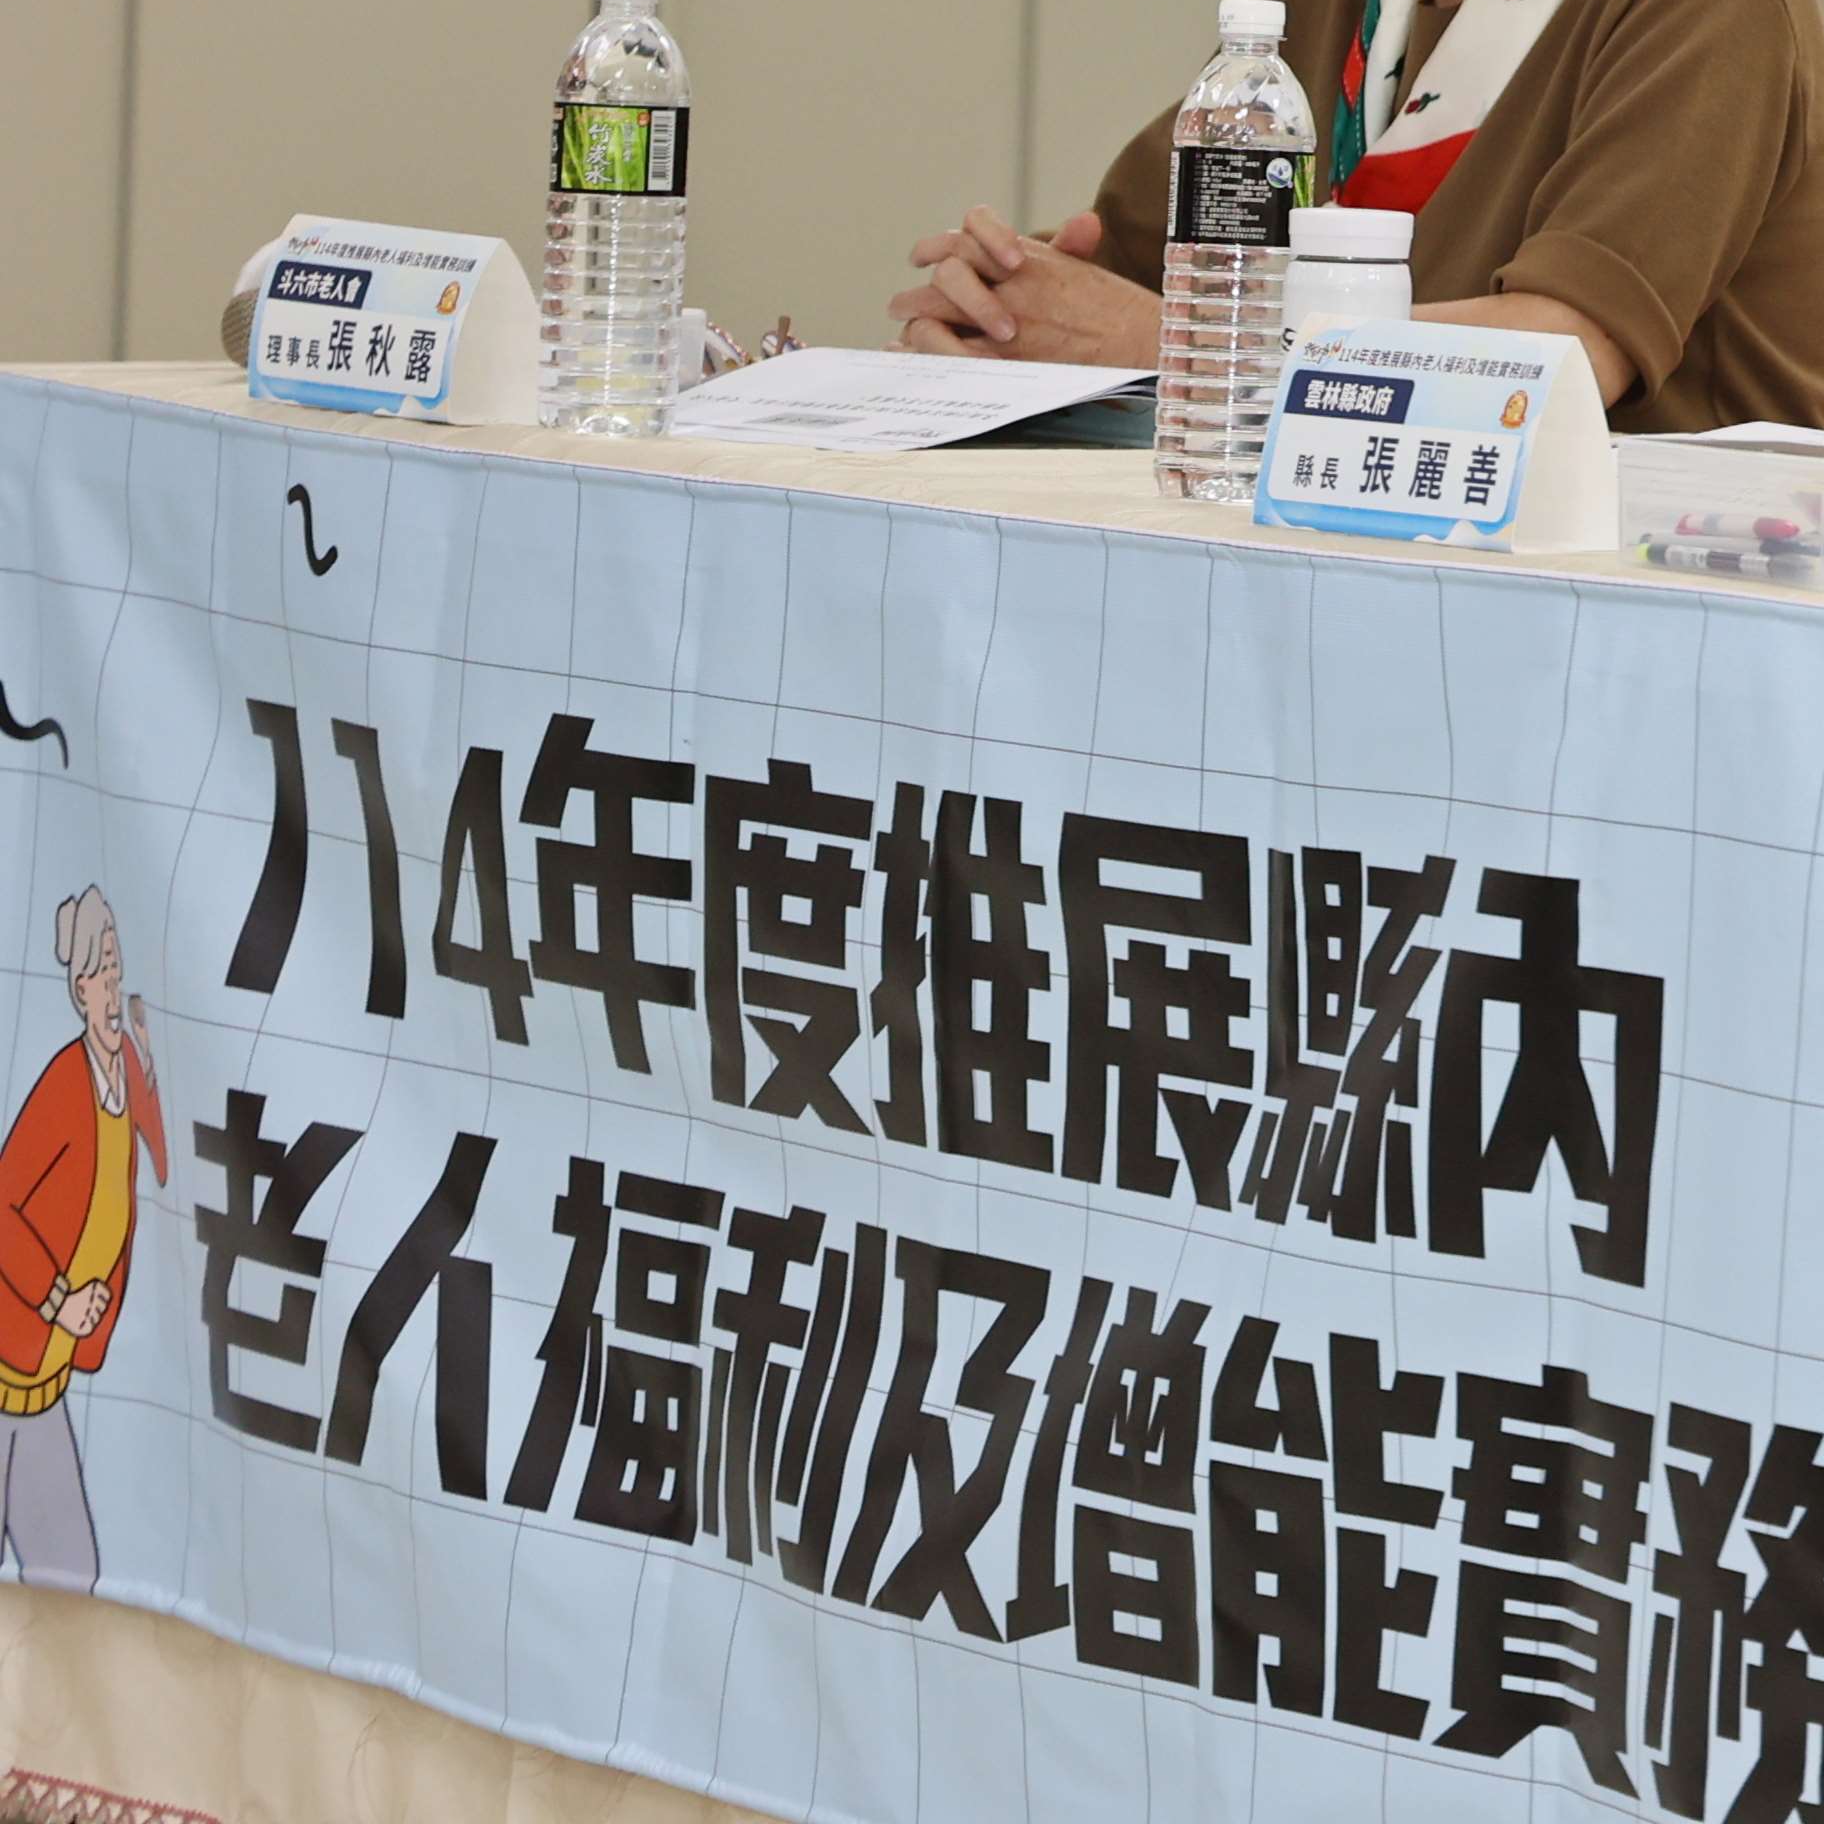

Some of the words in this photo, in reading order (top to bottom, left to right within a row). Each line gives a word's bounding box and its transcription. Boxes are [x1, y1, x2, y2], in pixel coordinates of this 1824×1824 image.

[277, 268, 362, 303] 斗六市老人會
[266, 334, 321, 369] 理事長
[327, 319, 436, 383] 張秋露
[1303, 379, 1396, 417] 雲林縣政府
[1292, 453, 1340, 491] 縣長
[1359, 435, 1501, 507] 張麗善
[225, 696, 1668, 1289] 114年度推展縣內
